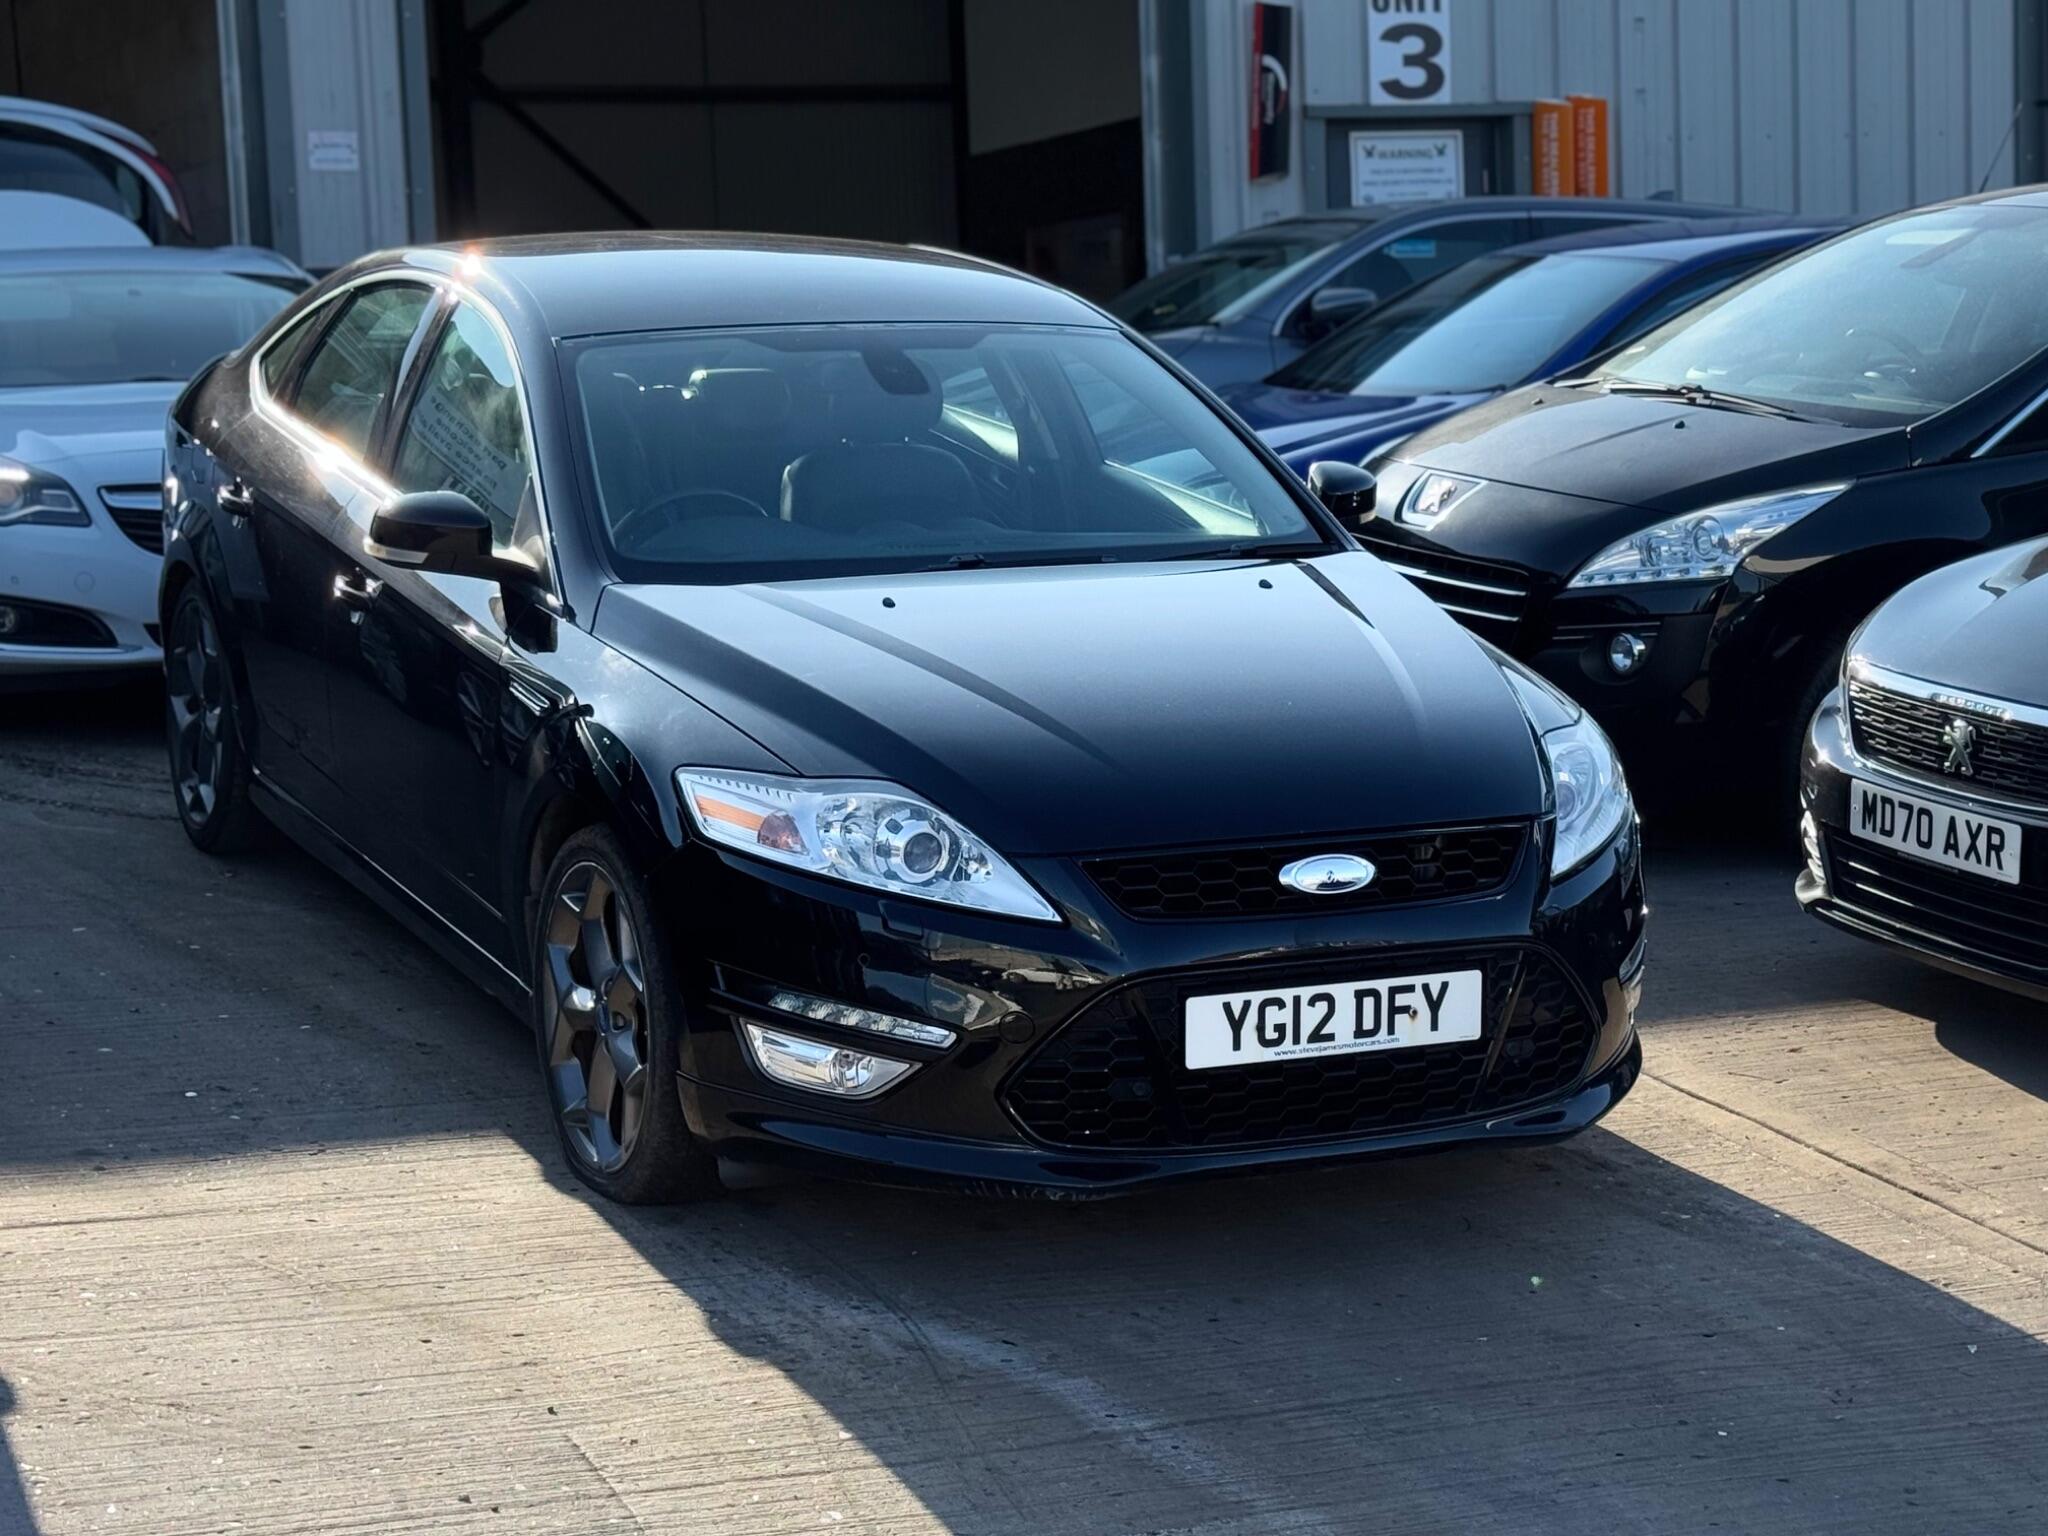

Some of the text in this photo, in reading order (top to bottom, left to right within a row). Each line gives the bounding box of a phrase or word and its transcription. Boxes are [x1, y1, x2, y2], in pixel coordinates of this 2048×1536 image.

[1379, 22, 1445, 100] 3
[1861, 789, 2006, 871] MD70 AXR
[1222, 981, 1450, 1052] YG12 DFY
